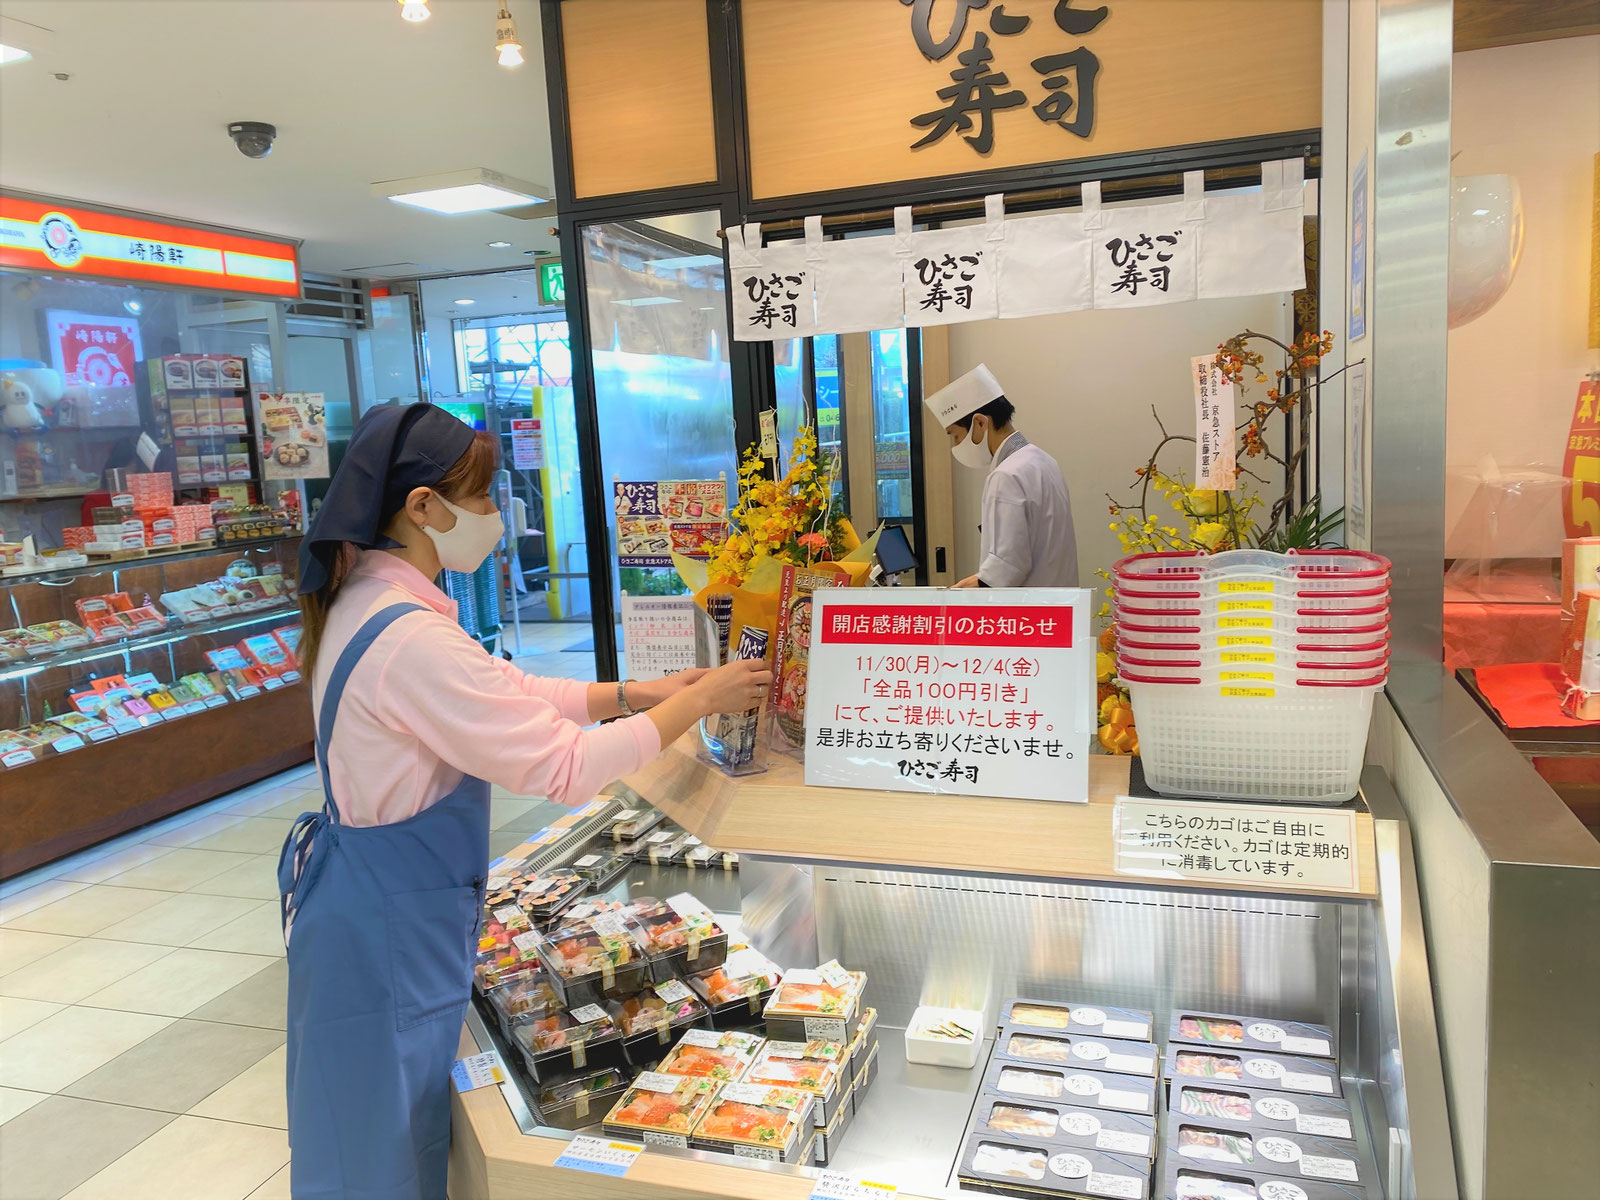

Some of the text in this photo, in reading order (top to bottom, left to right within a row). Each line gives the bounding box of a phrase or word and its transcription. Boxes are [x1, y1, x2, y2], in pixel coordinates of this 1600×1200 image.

[910, 31, 1100, 154] 寿司
[129, 241, 184, 265] 崎陽軒
[1105, 230, 1183, 267] ひさご
[914, 251, 984, 285] ひさご
[1110, 264, 1171, 297] 寿司
[743, 271, 806, 303] ひさご
[920, 283, 973, 313] 寿司
[748, 299, 798, 330] 寿司
[1212, 404, 1220, 462] 京急ストア
[625, 484, 656, 498] ひさご
[632, 497, 656, 514] 寿司
[832, 614, 1058, 637] 開店感謝割引のお知らせ
[835, 704, 1054, 732] にて、ご提供いたします。
[816, 728, 1074, 760] 是非お立ち寄りくださいませ。
[897, 758, 979, 784] ひさご寿司
[1145, 813, 1325, 837] こちらのカゴはご自由に
